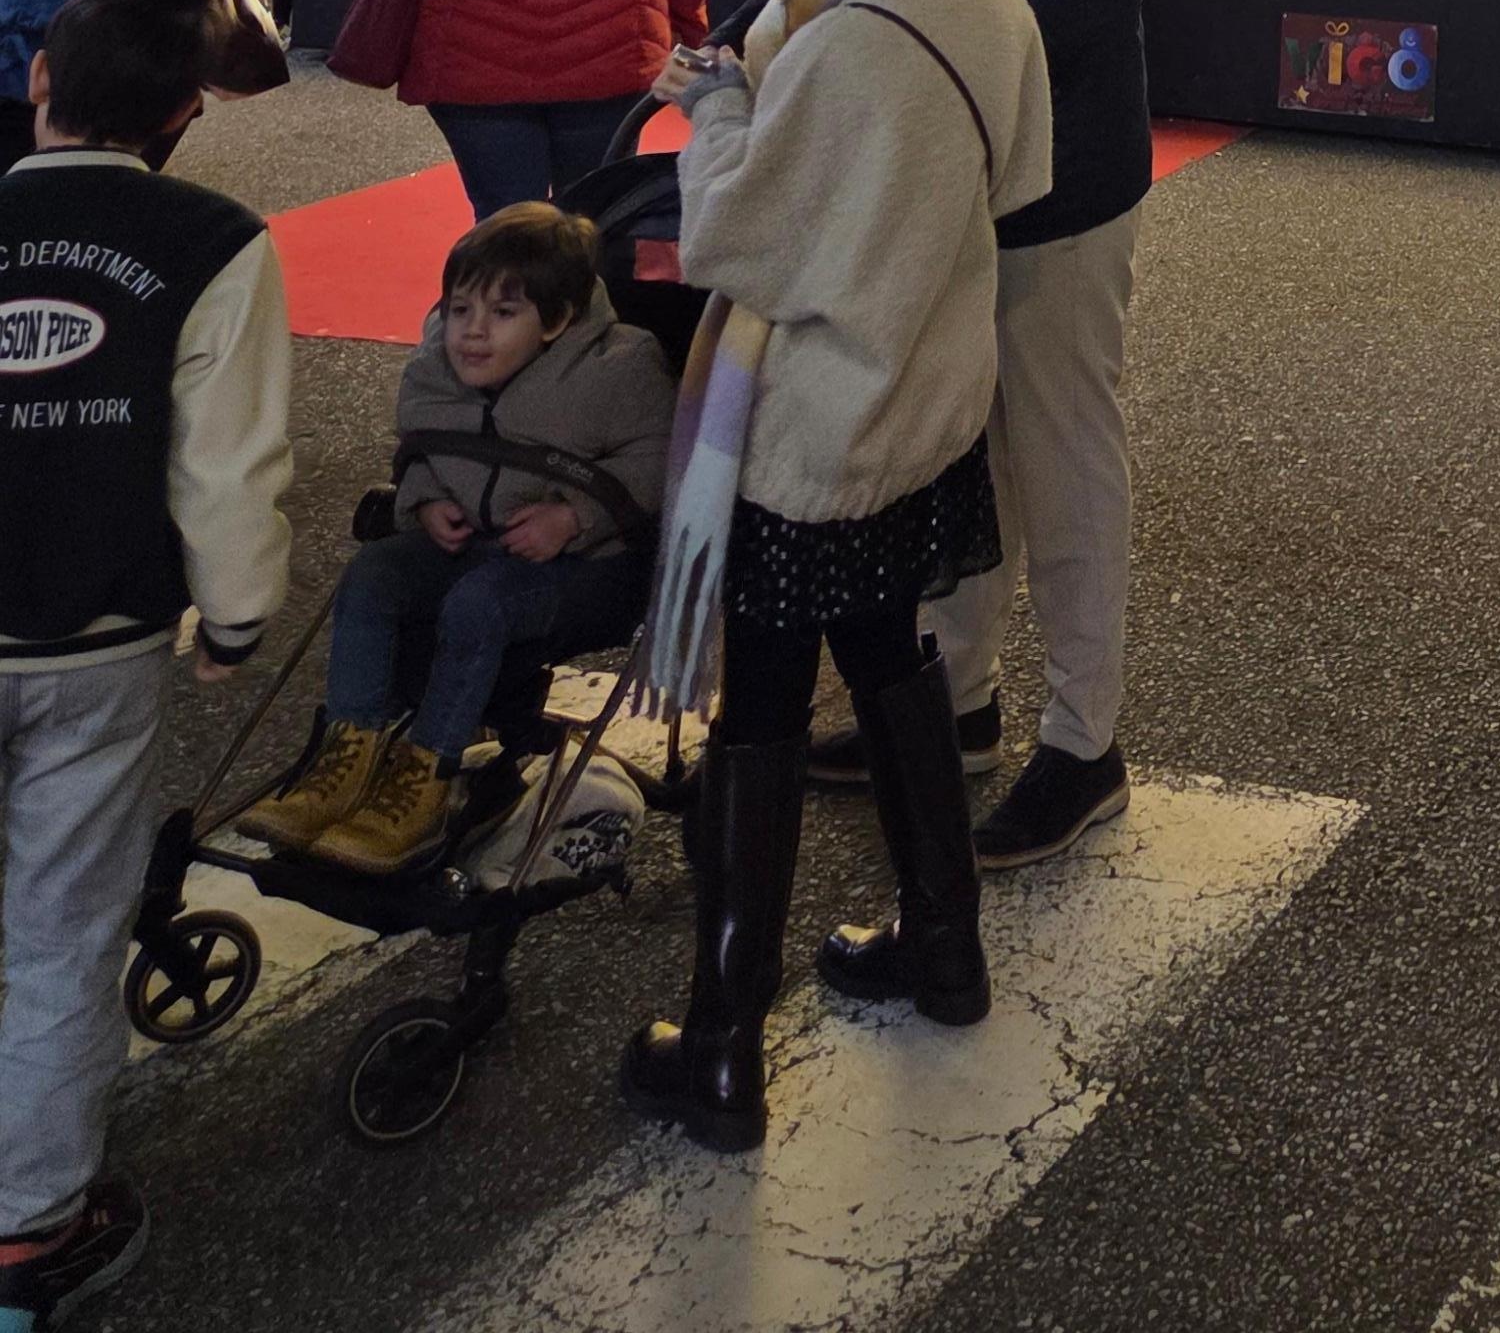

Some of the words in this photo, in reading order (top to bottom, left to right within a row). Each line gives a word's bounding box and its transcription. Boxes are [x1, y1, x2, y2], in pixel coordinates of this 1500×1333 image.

[20, 240, 165, 301] DEPARTMENT
[0, 310, 43, 360] SON
[44, 312, 92, 357] PIER
[11, 400, 69, 429] NEW
[78, 397, 132, 425] YORK
